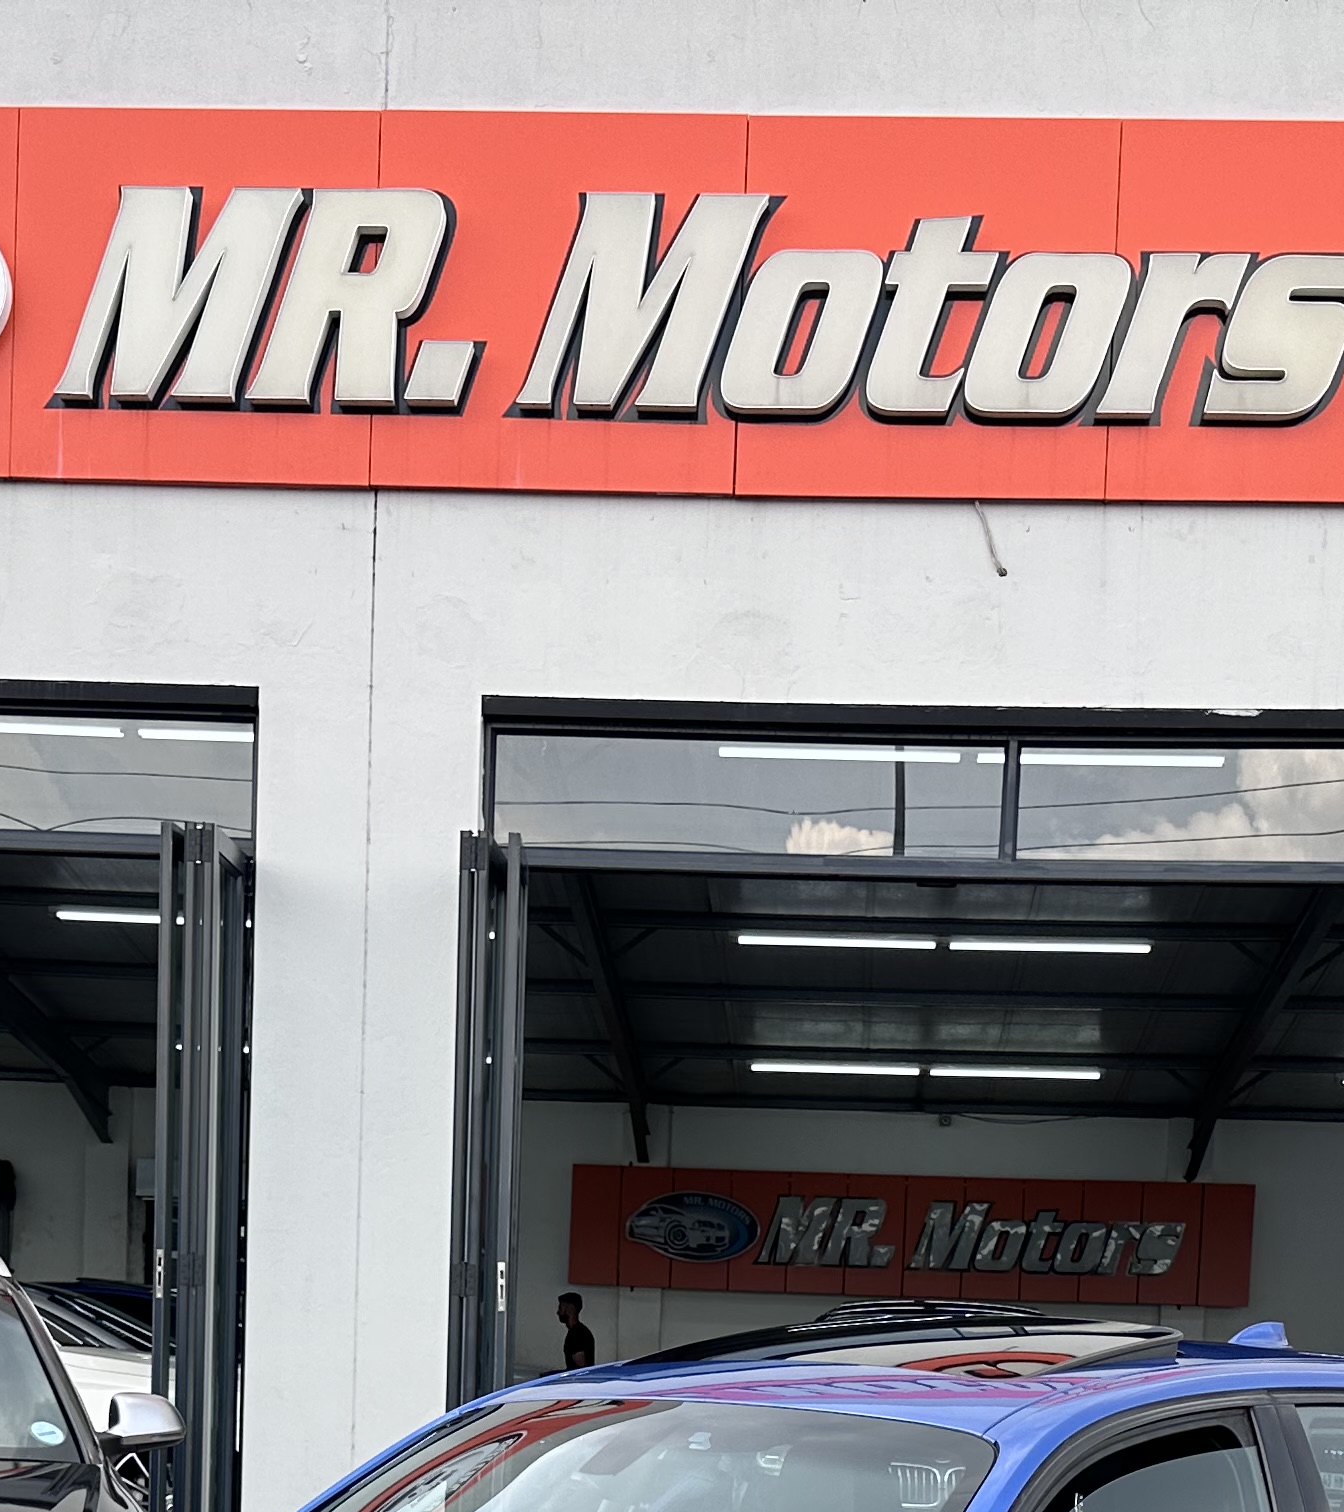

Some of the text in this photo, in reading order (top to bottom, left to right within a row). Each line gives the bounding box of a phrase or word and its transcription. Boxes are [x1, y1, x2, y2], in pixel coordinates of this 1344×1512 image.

[46, 185, 484, 414] MR.
[708, 1198, 751, 1225] MOTORS
[753, 1195, 1186, 1277] MR. Motors
